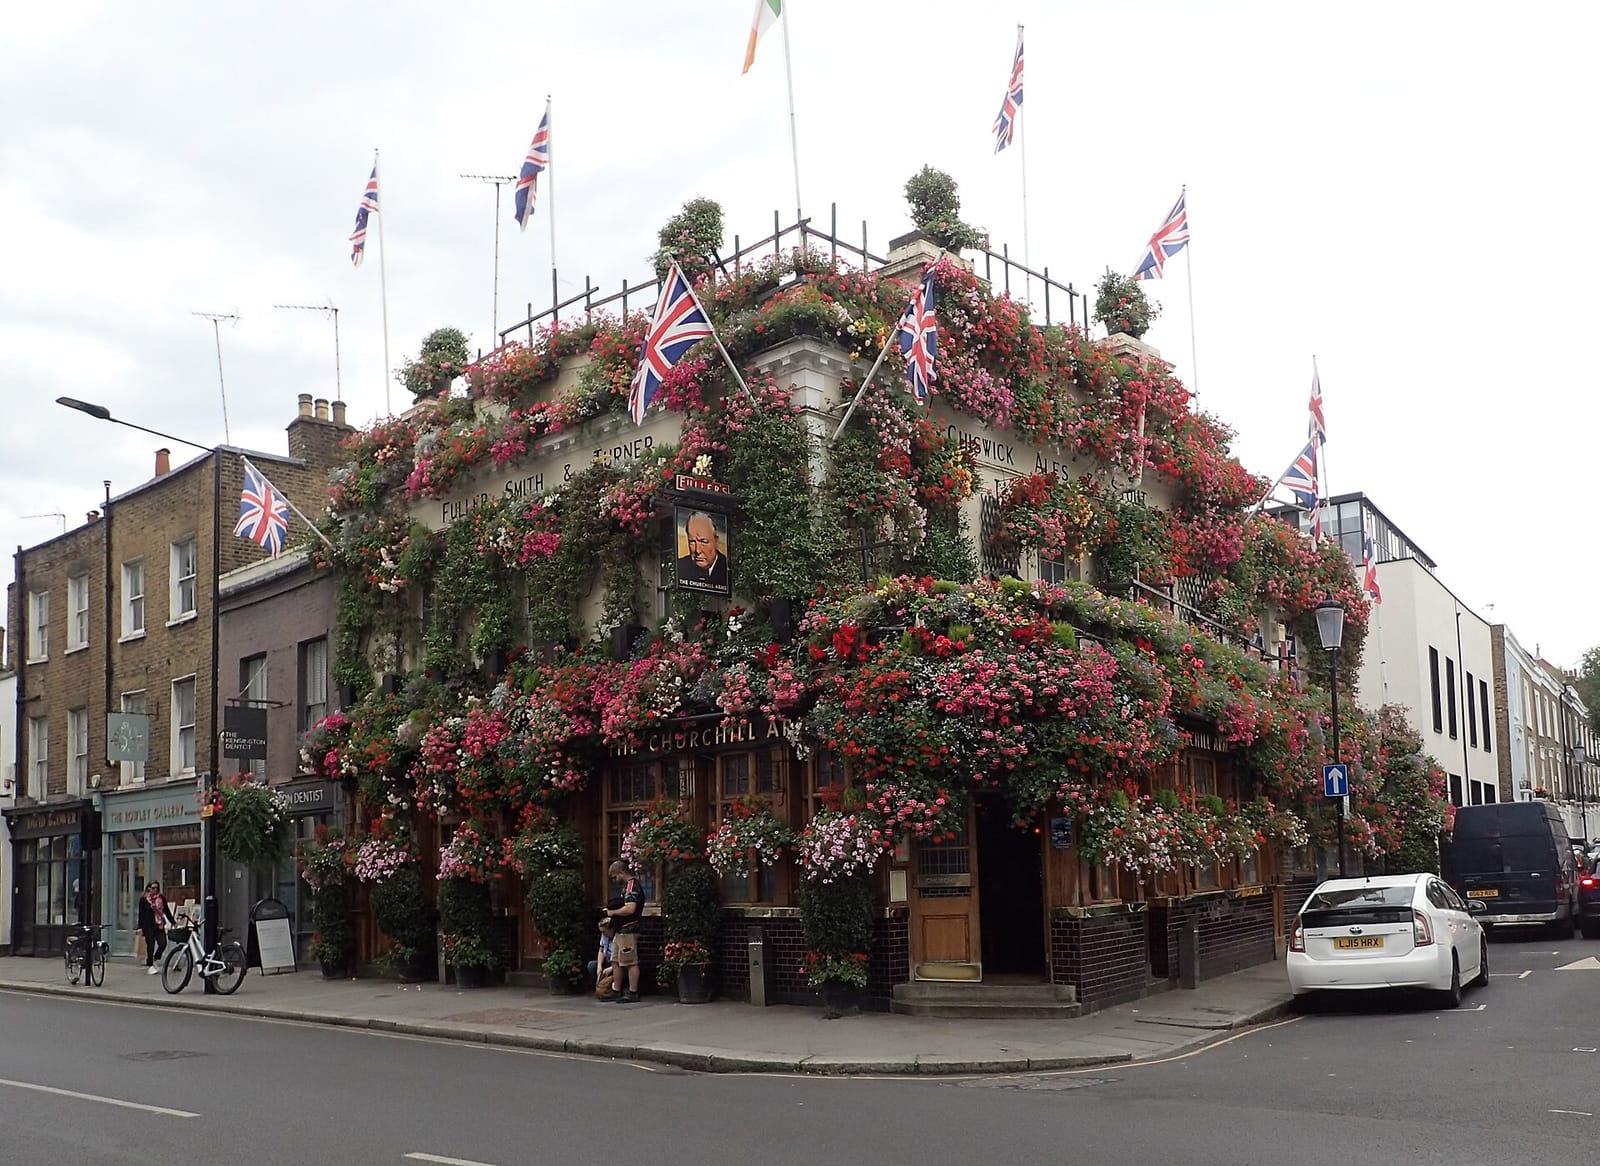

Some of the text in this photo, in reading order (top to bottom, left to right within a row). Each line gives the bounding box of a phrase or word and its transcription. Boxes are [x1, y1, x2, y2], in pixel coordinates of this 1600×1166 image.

[947, 424, 1015, 466] CHISWICK
[1035, 451, 1069, 481] ALES
[505, 473, 543, 499] SMITH
[563, 464, 571, 481] &
[593, 435, 654, 468] TURNER
[689, 580, 714, 589] CHURCHILL
[225, 737, 266, 745] KENSINGTON
[649, 721, 756, 752] CHURCHILL
[294, 789, 323, 804] DENTIST
[153, 804, 185, 819] GALLERY
[1339, 938, 1380, 948] LJ15 HRX
